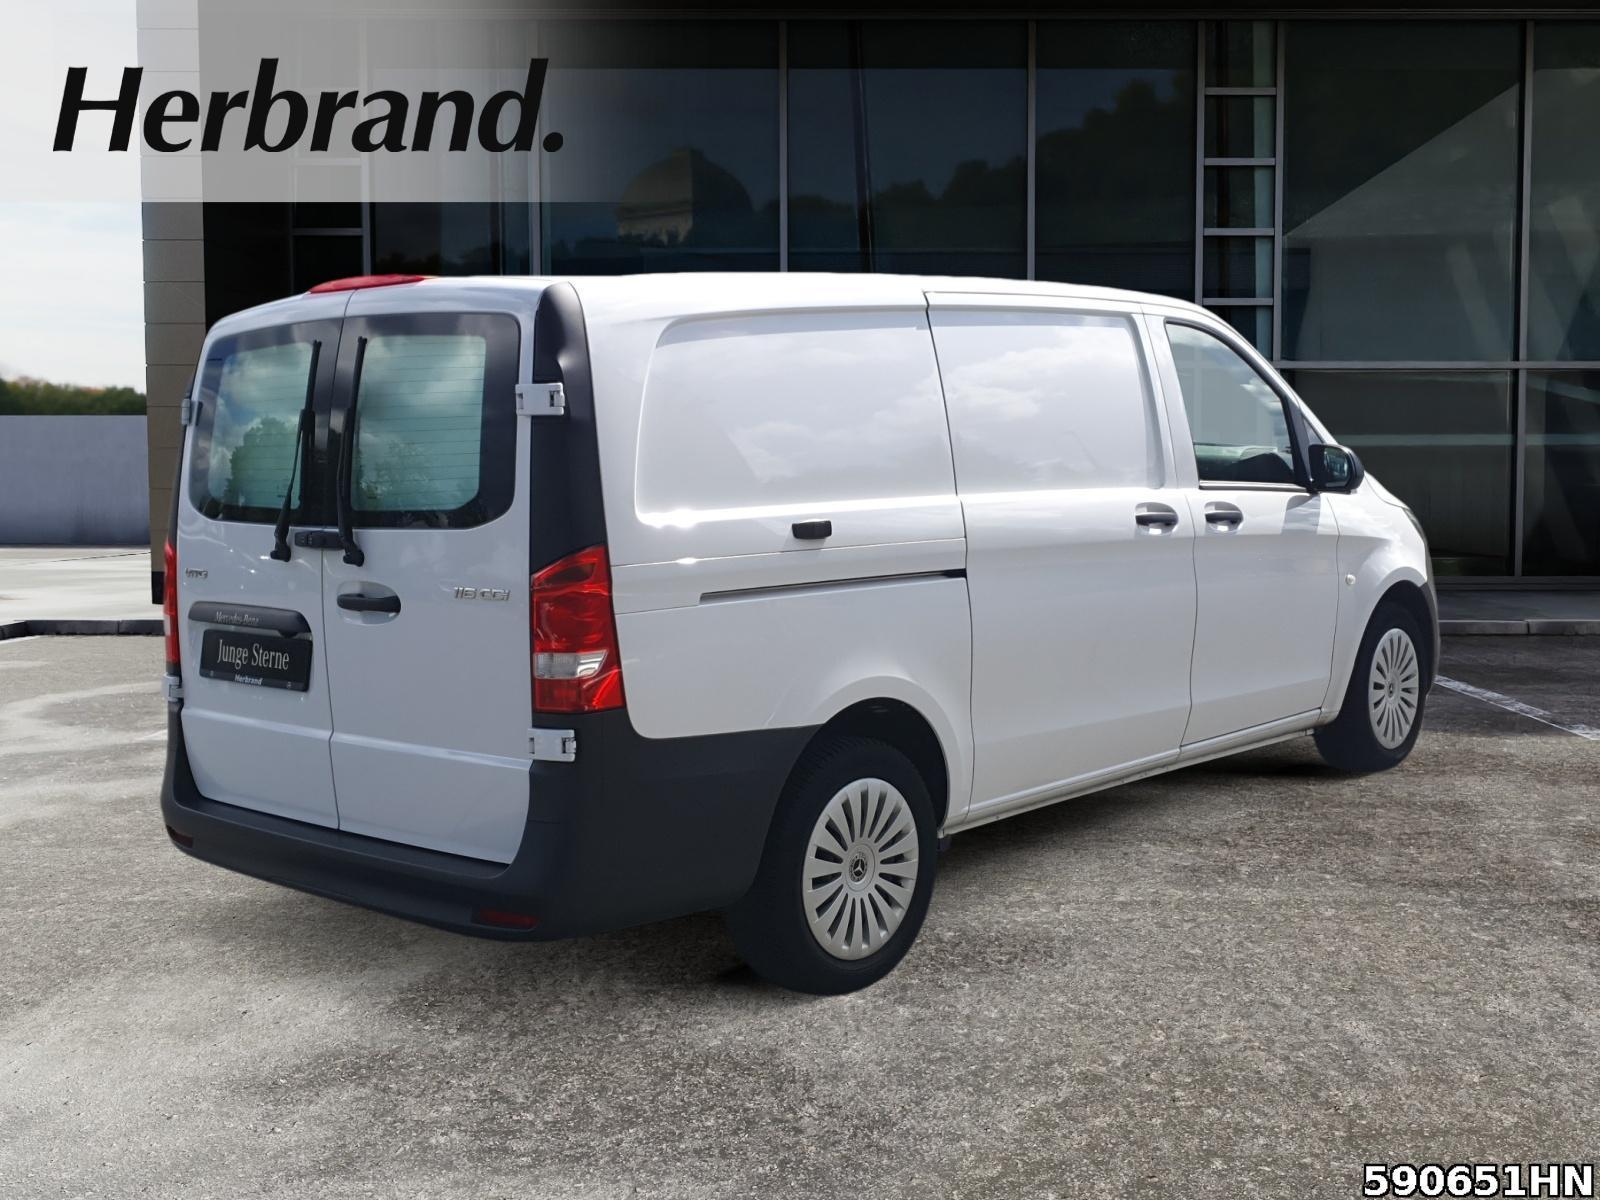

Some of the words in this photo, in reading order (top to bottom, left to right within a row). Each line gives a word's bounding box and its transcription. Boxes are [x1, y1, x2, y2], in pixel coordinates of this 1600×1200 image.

[217, 639, 249, 670] Junge
[251, 643, 290, 670] Sterne
[234, 674, 263, 686] Herbrand
